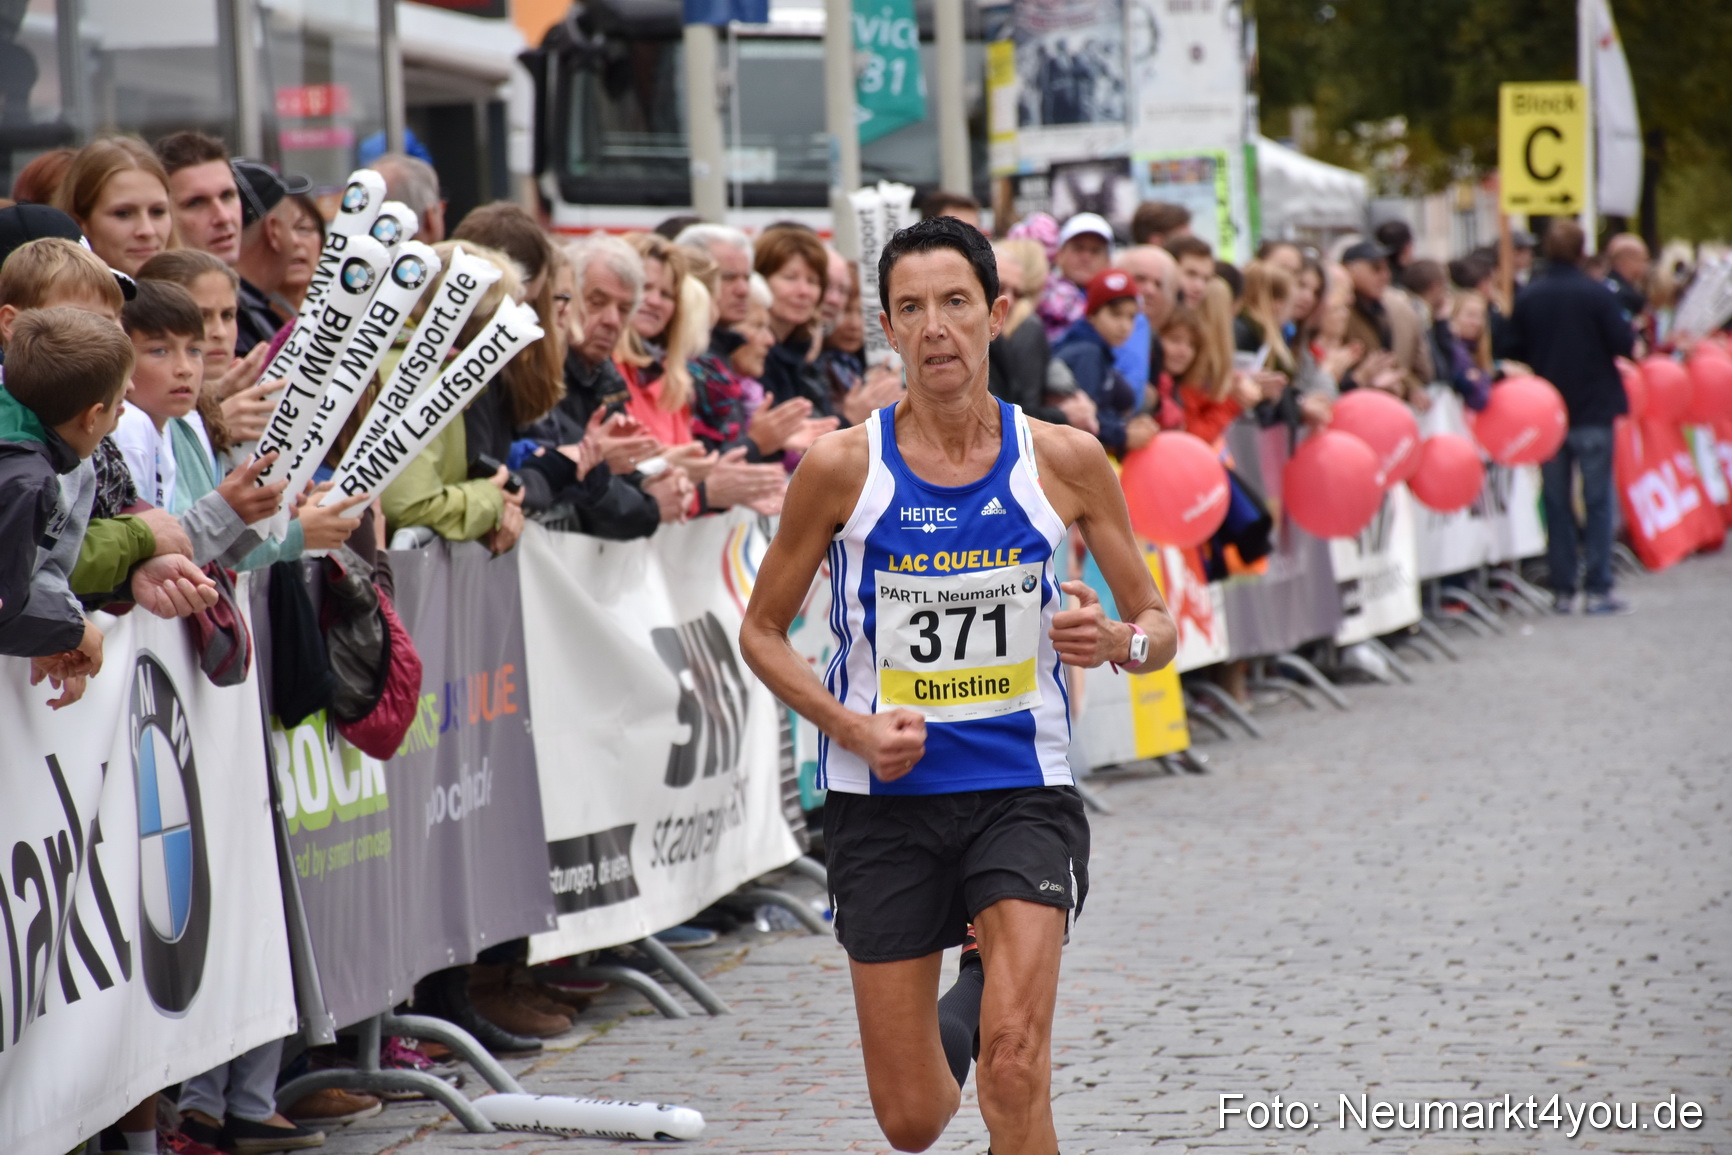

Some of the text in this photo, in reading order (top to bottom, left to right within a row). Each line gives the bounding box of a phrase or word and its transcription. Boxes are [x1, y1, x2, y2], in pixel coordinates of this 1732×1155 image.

[1512, 94, 1574, 115] Block
[1525, 125, 1562, 181] C
[298, 305, 353, 386] BMW
[340, 301, 400, 382] BMW
[340, 322, 518, 498] BMW Laufsport
[901, 507, 957, 521] HEITEC
[981, 506, 1006, 516] adidas
[889, 548, 1022, 572] LAC QUELLE
[880, 583, 1016, 604] PARTL Neumarkt
[909, 603, 1007, 663] 371
[883, 659, 890, 668] A
[914, 675, 1010, 701] Christine
